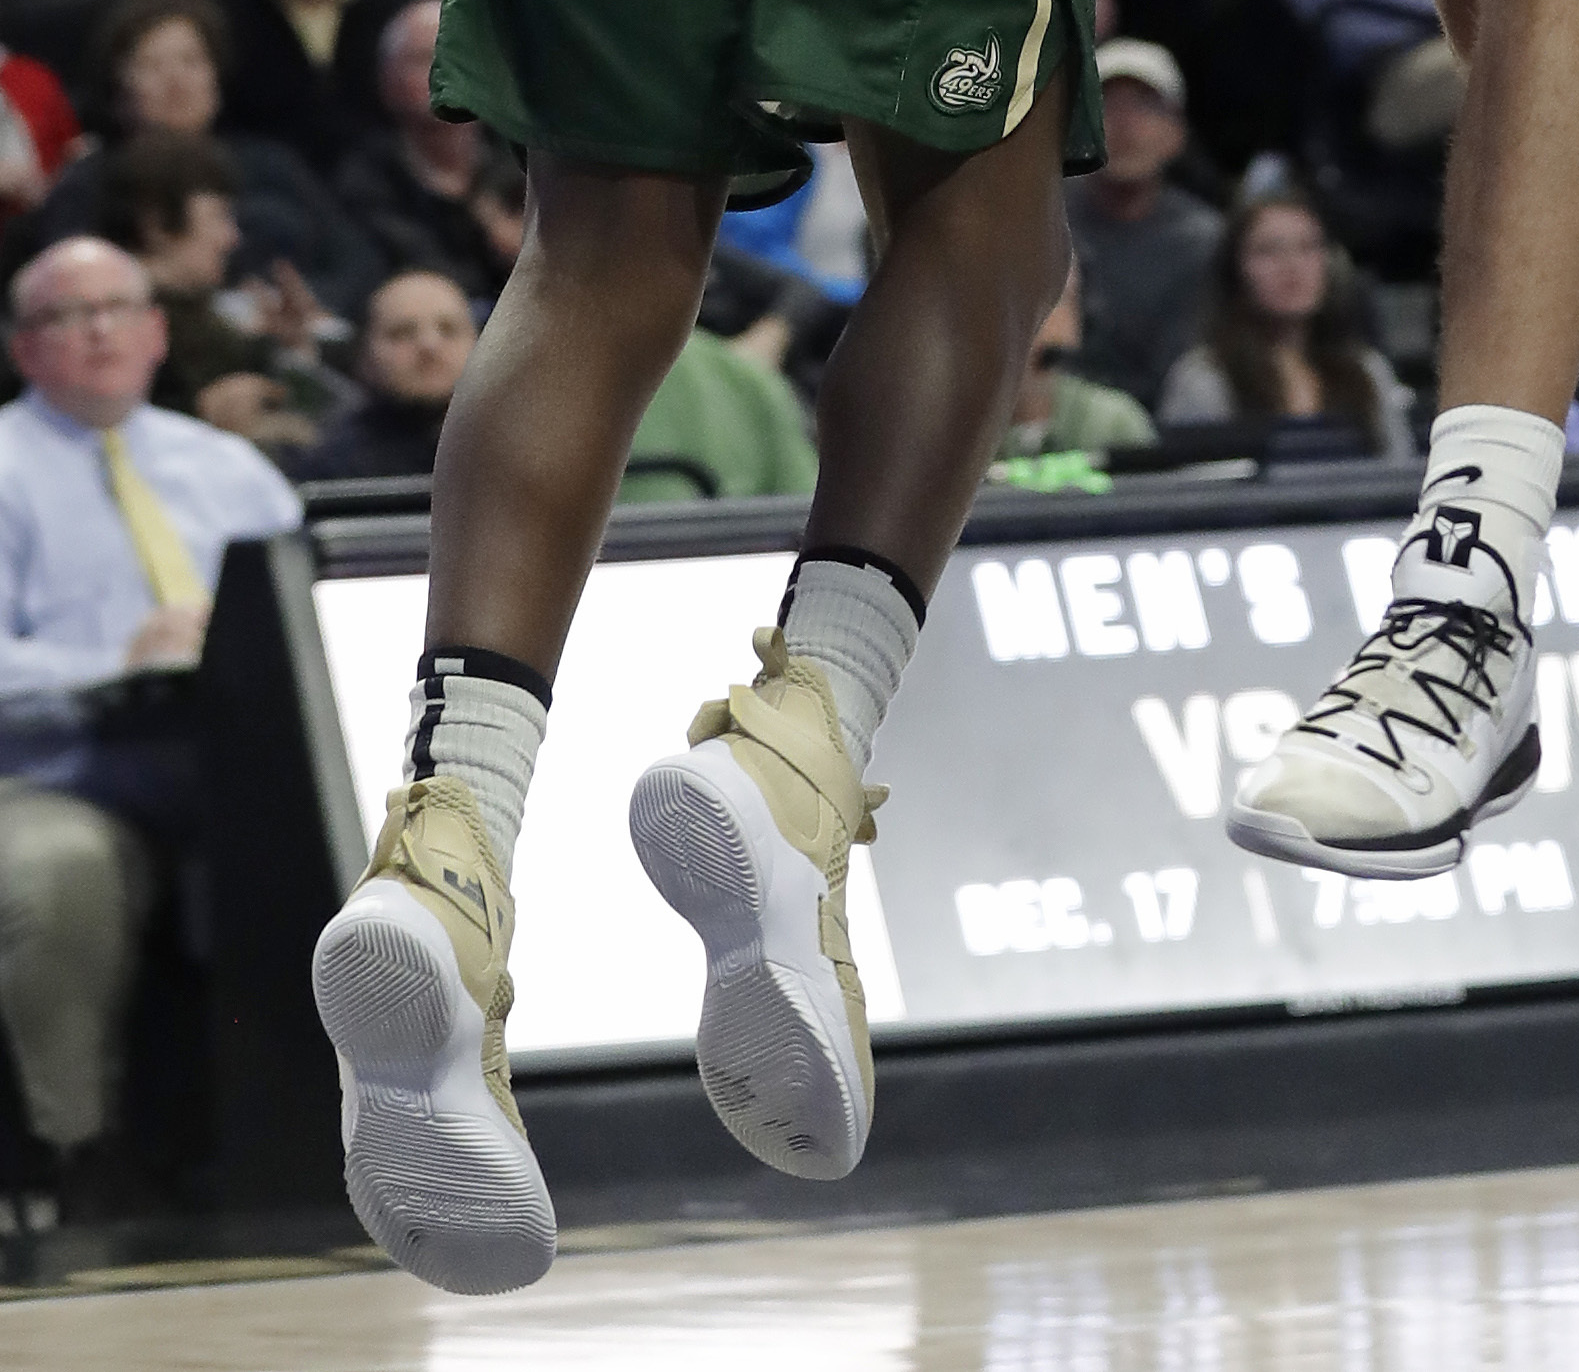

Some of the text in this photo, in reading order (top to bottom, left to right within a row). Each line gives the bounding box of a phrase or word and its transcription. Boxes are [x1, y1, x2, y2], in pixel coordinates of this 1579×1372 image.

[943, 77, 994, 99] 49ERS
[970, 542, 1313, 661] MEN'S
[1120, 865, 1201, 943] 17
[1469, 839, 1577, 917] PM
